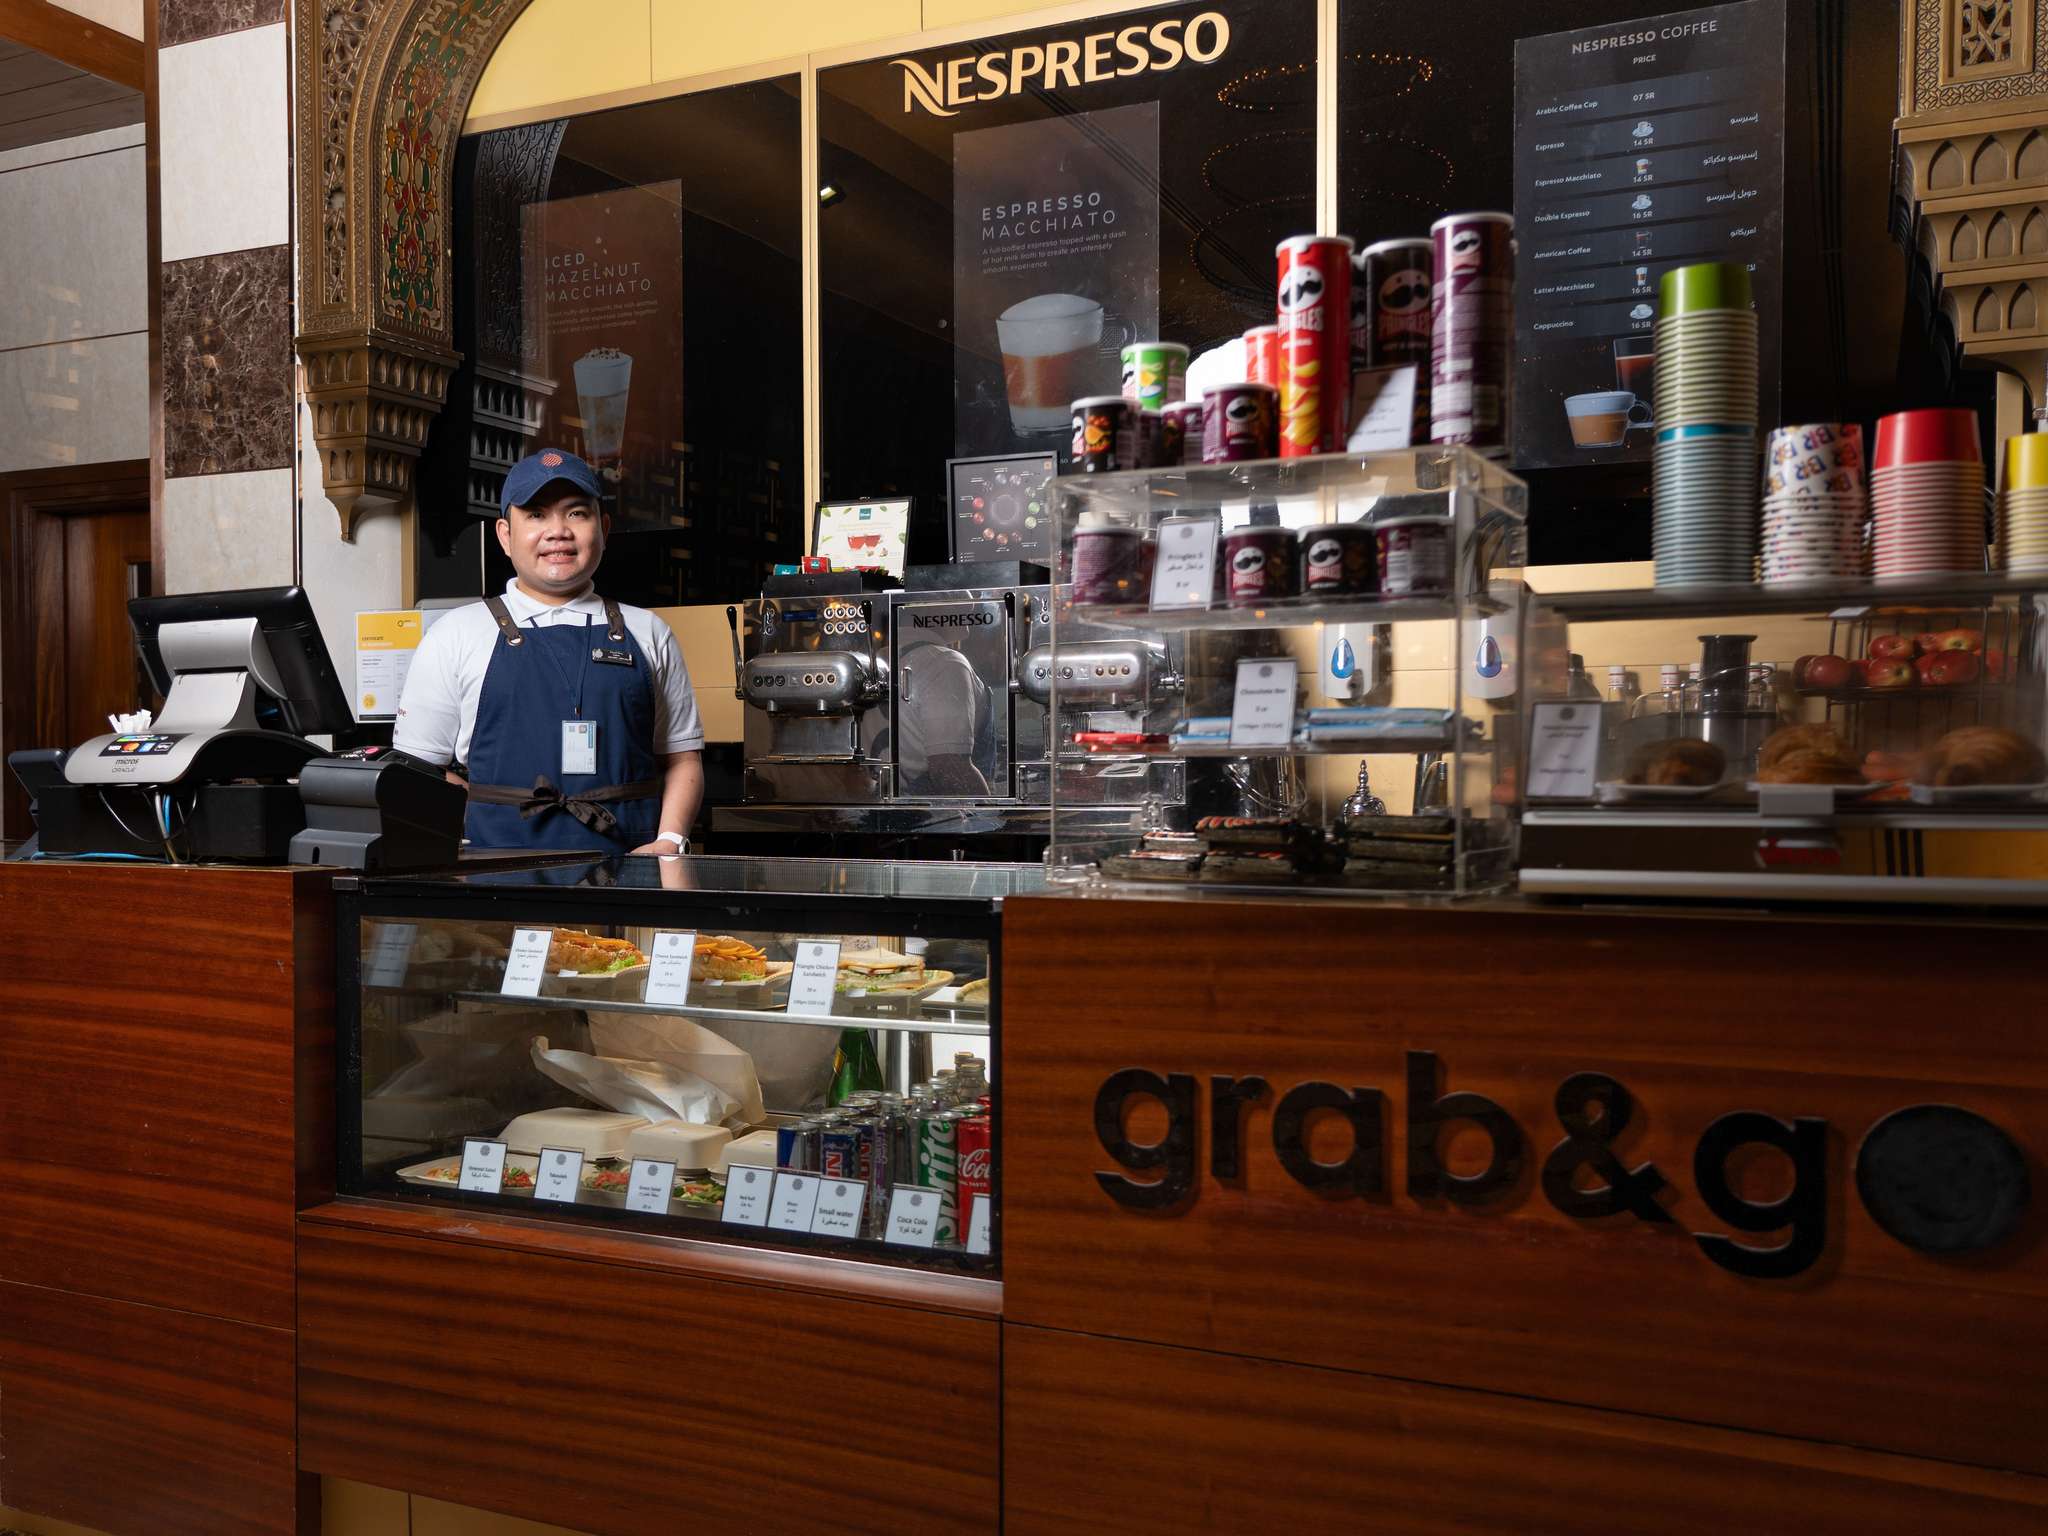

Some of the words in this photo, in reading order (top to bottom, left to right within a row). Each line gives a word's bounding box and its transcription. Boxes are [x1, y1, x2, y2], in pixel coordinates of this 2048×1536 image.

[1571, 30, 1657, 55] NESPRESSO
[1661, 20, 1719, 40] COFFEE
[889, 11, 1230, 117] NESPRESSO
[1632, 54, 1657, 65] PRICE
[1632, 93, 1643, 102] 07
[1644, 92, 1656, 101] SR
[1535, 107, 1559, 117] Arabic
[1559, 103, 1583, 113] Coffee
[1583, 100, 1600, 110] Cup
[1535, 142, 1566, 152] Espresso
[1633, 139, 1643, 147] 14
[1644, 137, 1655, 146] SR
[1535, 177, 1565, 188] Espresso
[1565, 172, 1603, 183] Macchiato
[1632, 175, 1642, 184] 14
[1643, 174, 1654, 183] SR
[981, 191, 1102, 222] ESPRESSO
[1534, 214, 1560, 223] Double
[1560, 210, 1591, 221] Espresso
[1642, 210, 1653, 219] SR
[981, 209, 1117, 241] MACCHIATO
[1026, 239, 1058, 252] espresso
[1059, 236, 1084, 248] topped
[1085, 233, 1102, 244] with
[1108, 229, 1127, 240] dash
[991, 255, 1003, 265] hot
[1003, 253, 1019, 263] milk
[1019, 251, 1038, 262] froth
[1038, 251, 1046, 259] to
[1046, 247, 1070, 257] create
[1080, 241, 1113, 255] intensely
[1534, 250, 1567, 260] American
[1567, 246, 1592, 256] Coffee
[1642, 248, 1653, 257] SR
[544, 252, 586, 270] ICED
[544, 262, 641, 288] HAZELNUT
[544, 278, 652, 305] MACCHIATO
[1642, 285, 1653, 295] SR
[1533, 320, 1575, 332] Cappuccino
[1642, 320, 1652, 330] SR
[913, 612, 995, 629] NESPRESSO
[818, 1207, 835, 1217] Small
[836, 1210, 855, 1218] water
[897, 1215, 913, 1225] Coca
[913, 1217, 929, 1226] Cola
